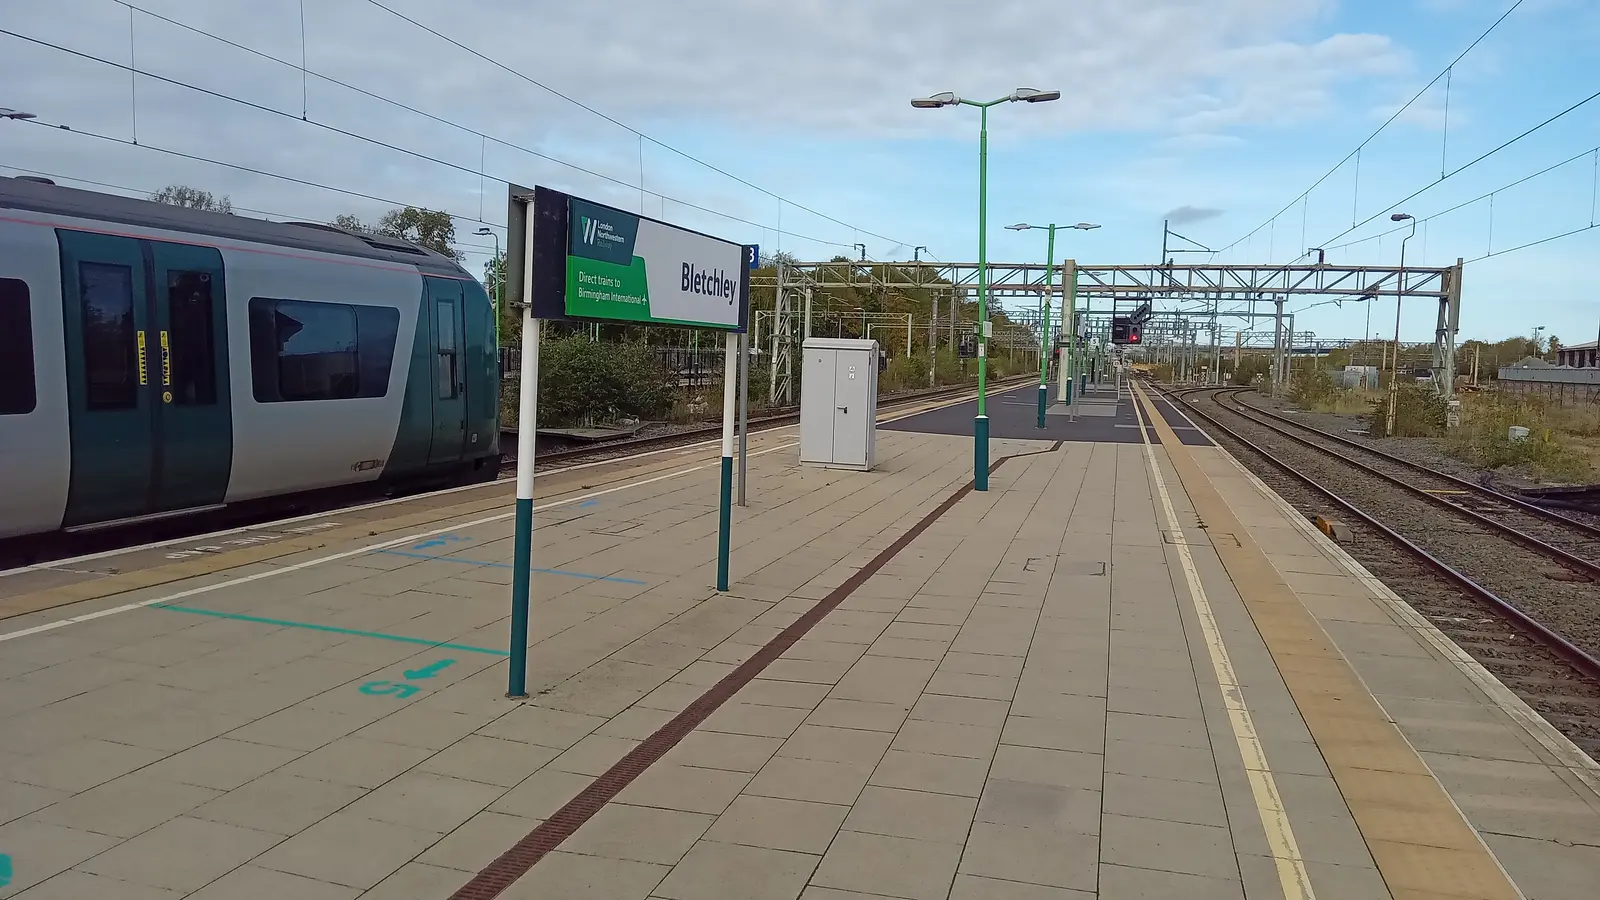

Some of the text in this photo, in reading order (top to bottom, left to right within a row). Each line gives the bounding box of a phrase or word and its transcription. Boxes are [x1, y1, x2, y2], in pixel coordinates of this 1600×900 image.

[597, 220, 613, 231] London
[597, 230, 625, 243] Northwestern
[578, 270, 621, 288] Direct trains to
[681, 262, 736, 305] Bletchley
[578, 287, 642, 305] Birmingham International
